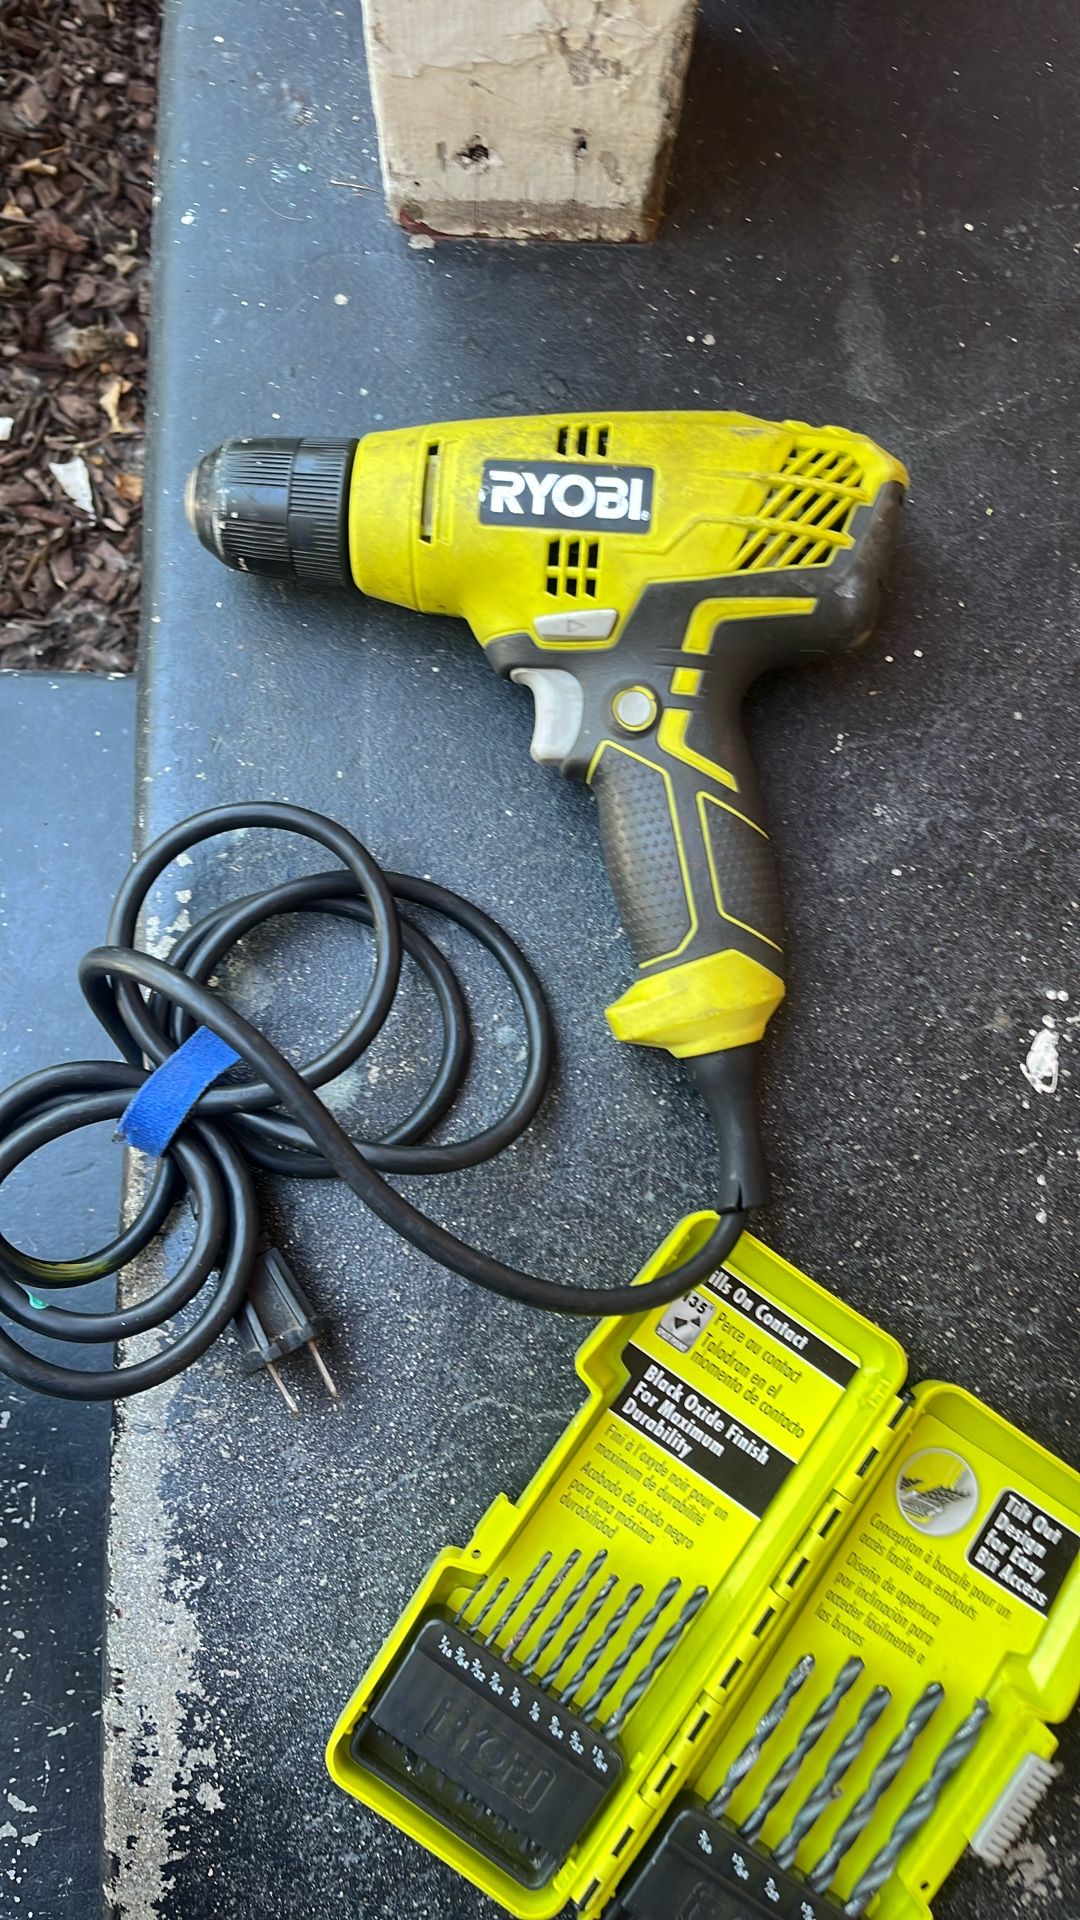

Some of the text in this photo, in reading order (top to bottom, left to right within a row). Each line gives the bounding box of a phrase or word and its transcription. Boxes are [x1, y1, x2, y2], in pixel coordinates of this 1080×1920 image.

[489, 470, 644, 521] RYOBI
[708, 1271, 809, 1350] ills On Contact
[701, 1332, 783, 1400] Taladran en el
[713, 1312, 802, 1383] Perce au contact
[621, 1397, 693, 1459] Durability
[632, 1380, 725, 1457] For Maximum
[643, 1364, 770, 1466] Black Oxide Finish
[690, 1350, 804, 1439] momento de contacto
[582, 1462, 622, 1497] Acabado
[622, 1490, 637, 1507] de
[663, 1520, 694, 1549] negro
[593, 1442, 705, 1526] maximum de durabilité
[604, 1424, 624, 1441] Fini
[668, 1473, 690, 1493] noir
[686, 1488, 715, 1515] pour
[713, 1506, 729, 1521] un
[561, 1493, 619, 1540] durabilidad
[570, 1480, 655, 1544] para una máxima
[994, 1512, 1047, 1559] Design
[1004, 1494, 1063, 1545] Tilt Out
[845, 1551, 941, 1627] Diseño de apertura
[869, 1513, 923, 1562] Conception
[932, 1555, 971, 1592] bascule
[969, 1585, 997, 1610] pour
[995, 1602, 1012, 1620] un
[884, 1548, 913, 1574] facile
[913, 1569, 933, 1588] aux
[932, 1583, 979, 1621] embouts
[974, 1545, 1048, 1607] Bit Access
[983, 1528, 1046, 1583] for Easy
[814, 1601, 866, 1647] las brocas
[825, 1589, 864, 1621] acceder
[834, 1571, 855, 1590] por
[907, 1620, 934, 1646] para
